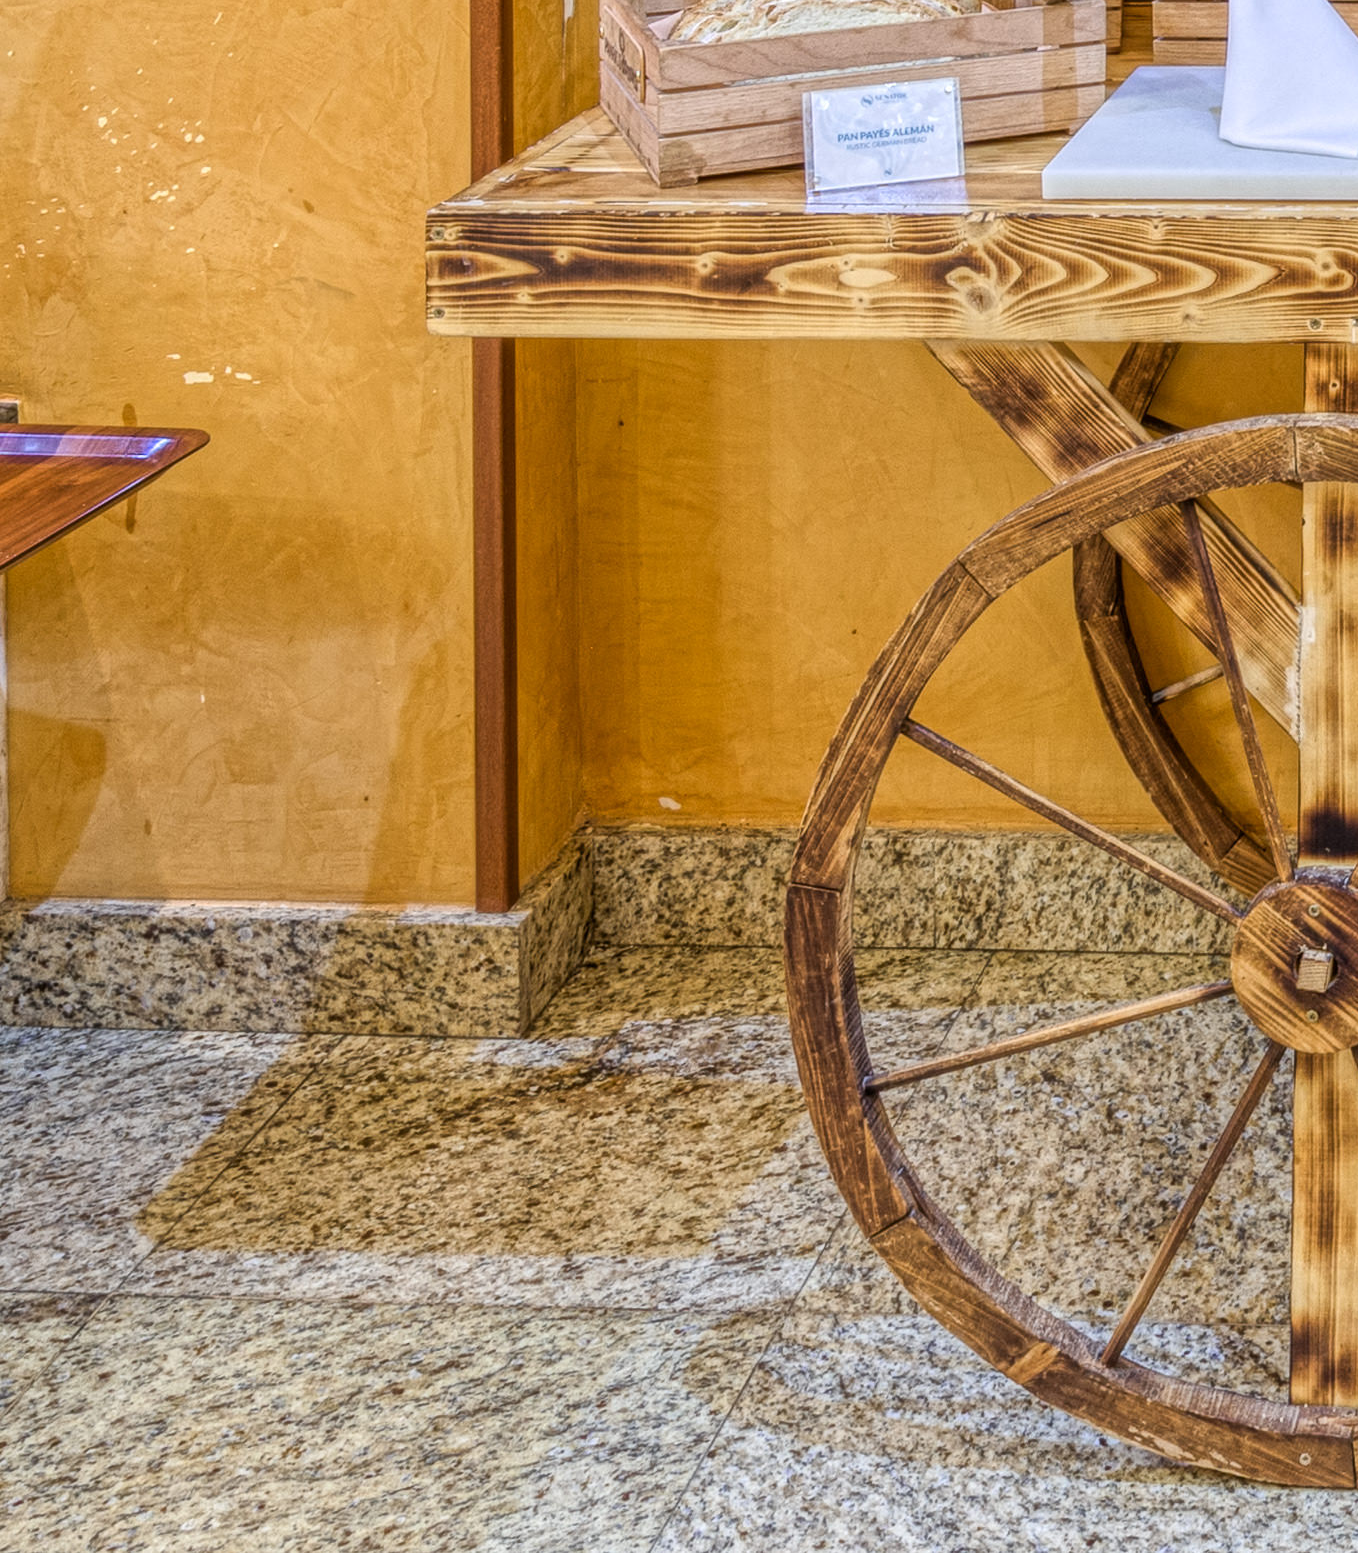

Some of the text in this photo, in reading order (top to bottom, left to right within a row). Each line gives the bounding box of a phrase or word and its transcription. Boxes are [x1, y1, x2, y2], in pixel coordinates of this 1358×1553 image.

[837, 125, 935, 142] PAN PAYÉS ALEMÁN
